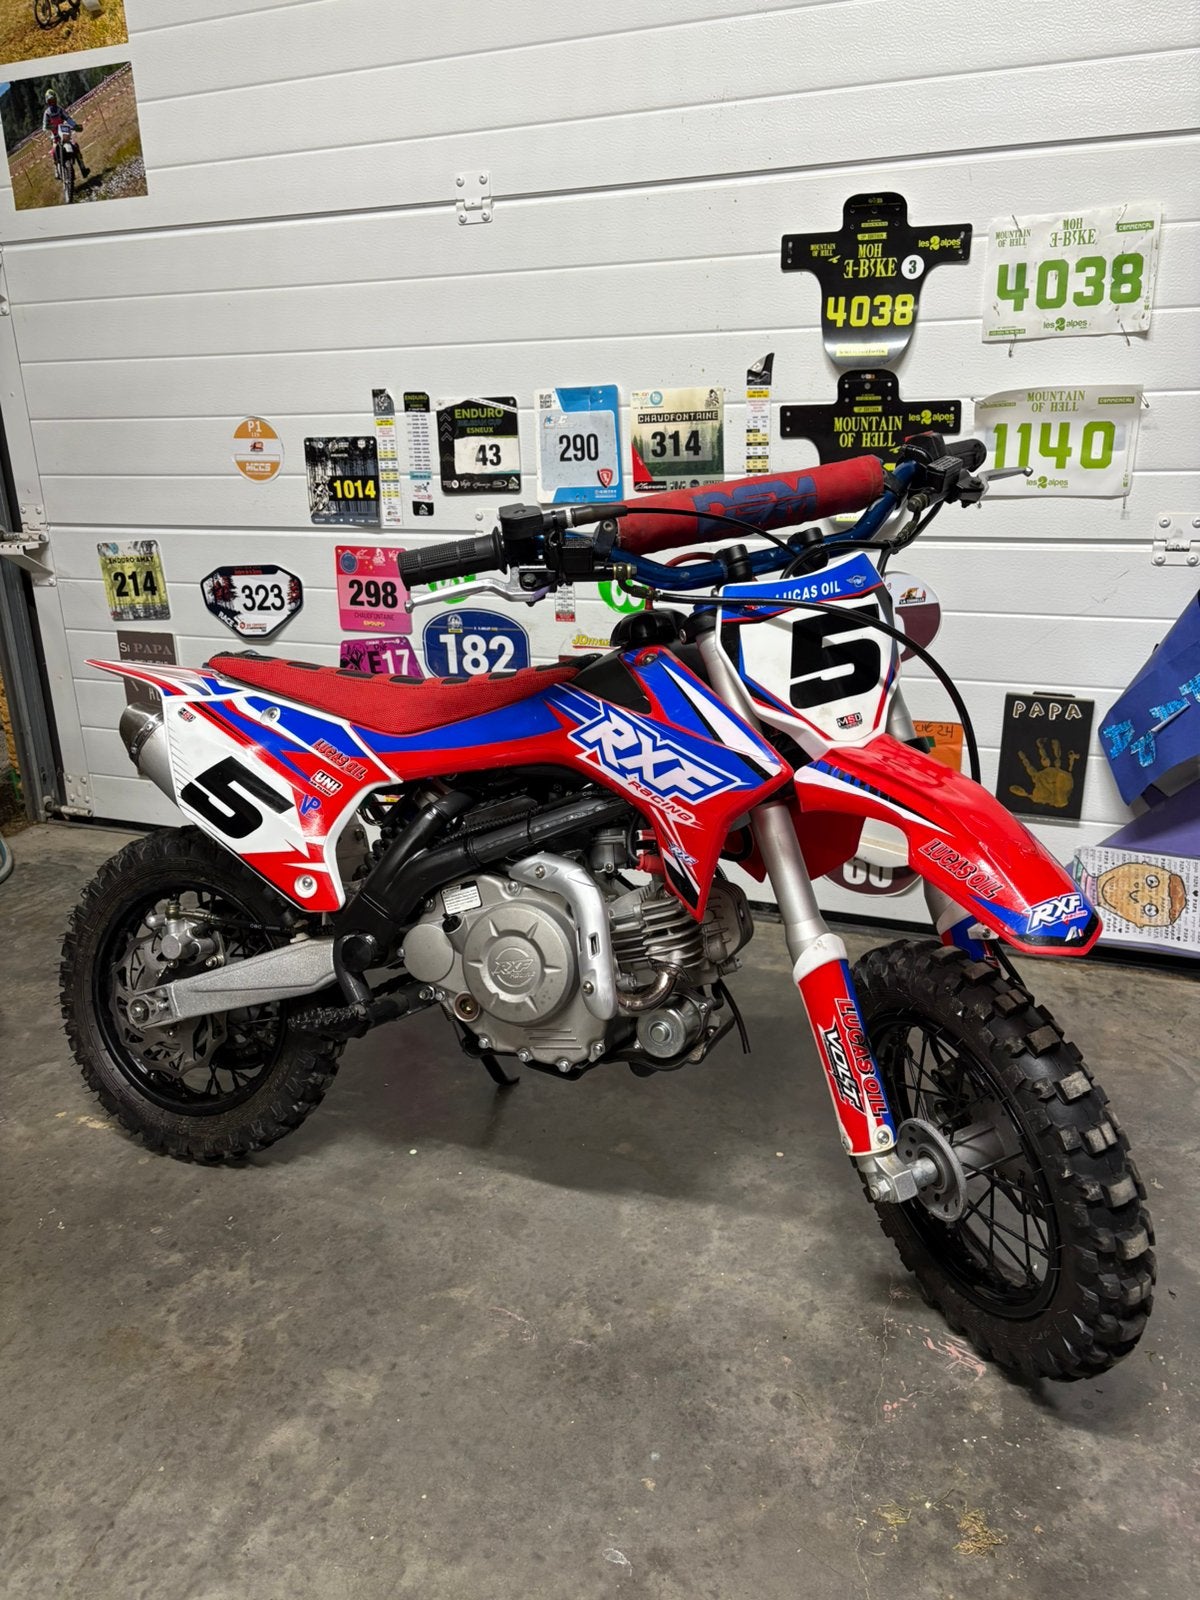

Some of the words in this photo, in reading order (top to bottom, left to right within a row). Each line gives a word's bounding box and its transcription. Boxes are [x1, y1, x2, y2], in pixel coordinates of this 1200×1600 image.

[996, 229, 1031, 241] MOUNTAIN
[1063, 217, 1083, 231] MOH
[858, 243, 883, 258] MOH
[998, 240, 1009, 249] OF
[908, 259, 918, 275] 3
[997, 252, 1144, 312] 4038
[826, 294, 915, 327] 4038
[1027, 391, 1086, 402] MOUNTAIN
[1032, 402, 1044, 413] OF
[454, 407, 505, 419] ENDURO
[834, 416, 903, 432] MOUNTAIN
[247, 420, 262, 432] P1
[559, 433, 599, 462] 290
[651, 430, 702, 457] 314
[839, 434, 856, 447] OF
[993, 421, 1115, 470] 1140
[475, 444, 502, 466] 43
[333, 480, 377, 499] 1014
[113, 570, 158, 597] 214
[348, 579, 399, 609] 298
[821, 580, 841, 594] OIL
[241, 584, 285, 612] 323
[133, 643, 173, 656] PAPA
[438, 634, 518, 676] 182
[790, 603, 881, 709] 5
[1012, 700, 1082, 721] PAPA
[312, 738, 349, 769] LUCAS
[344, 762, 368, 781] OIL
[577, 708, 726, 797] RXF
[314, 770, 342, 793] UNI
[180, 755, 295, 839] 5
[300, 795, 321, 816] VP
[628, 780, 694, 822] RACING
[917, 838, 975, 881] LUCAS
[966, 865, 1004, 901] OIL
[1025, 892, 1084, 933] RXF
[823, 1028, 866, 1114] VOLT
[835, 999, 874, 1076] LUCAS
[862, 1075, 888, 1118] OIL
